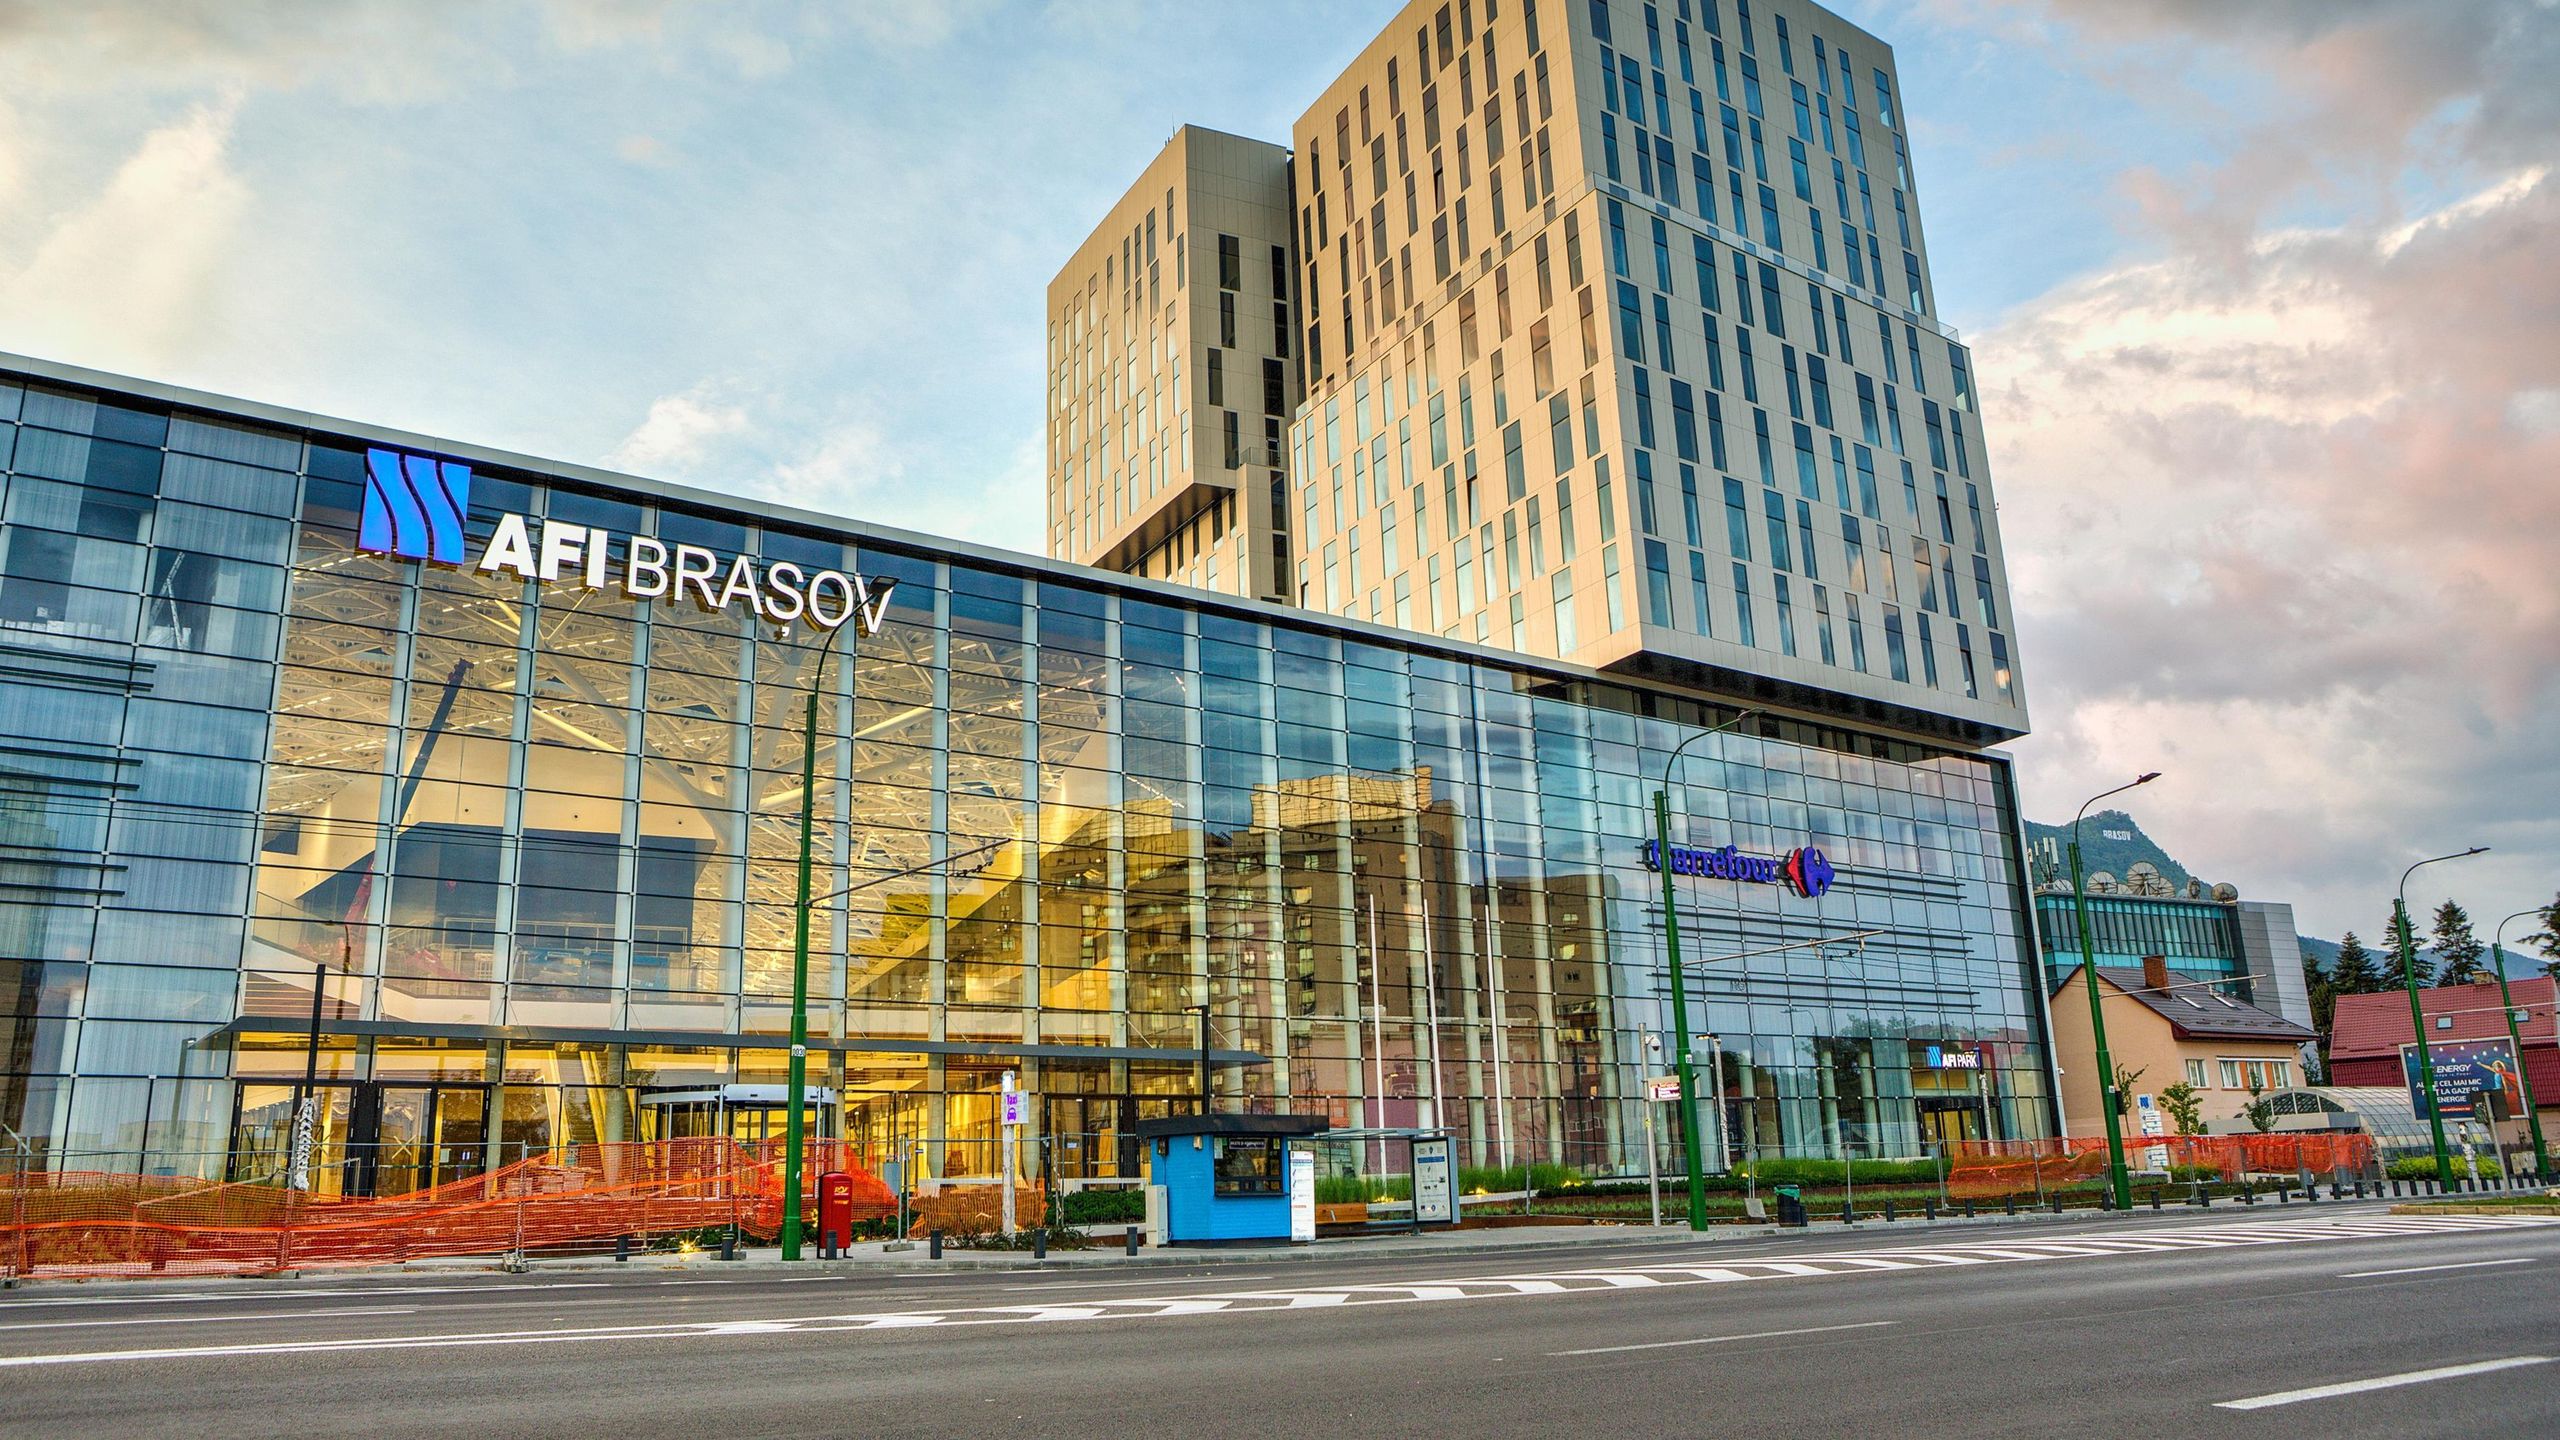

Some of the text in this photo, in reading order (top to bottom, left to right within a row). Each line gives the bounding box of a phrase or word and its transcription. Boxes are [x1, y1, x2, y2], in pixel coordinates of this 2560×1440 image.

[479, 512, 609, 590] AFI
[1942, 1053, 1978, 1068] AFI PARK
[1006, 1094, 1018, 1105] Taxi
